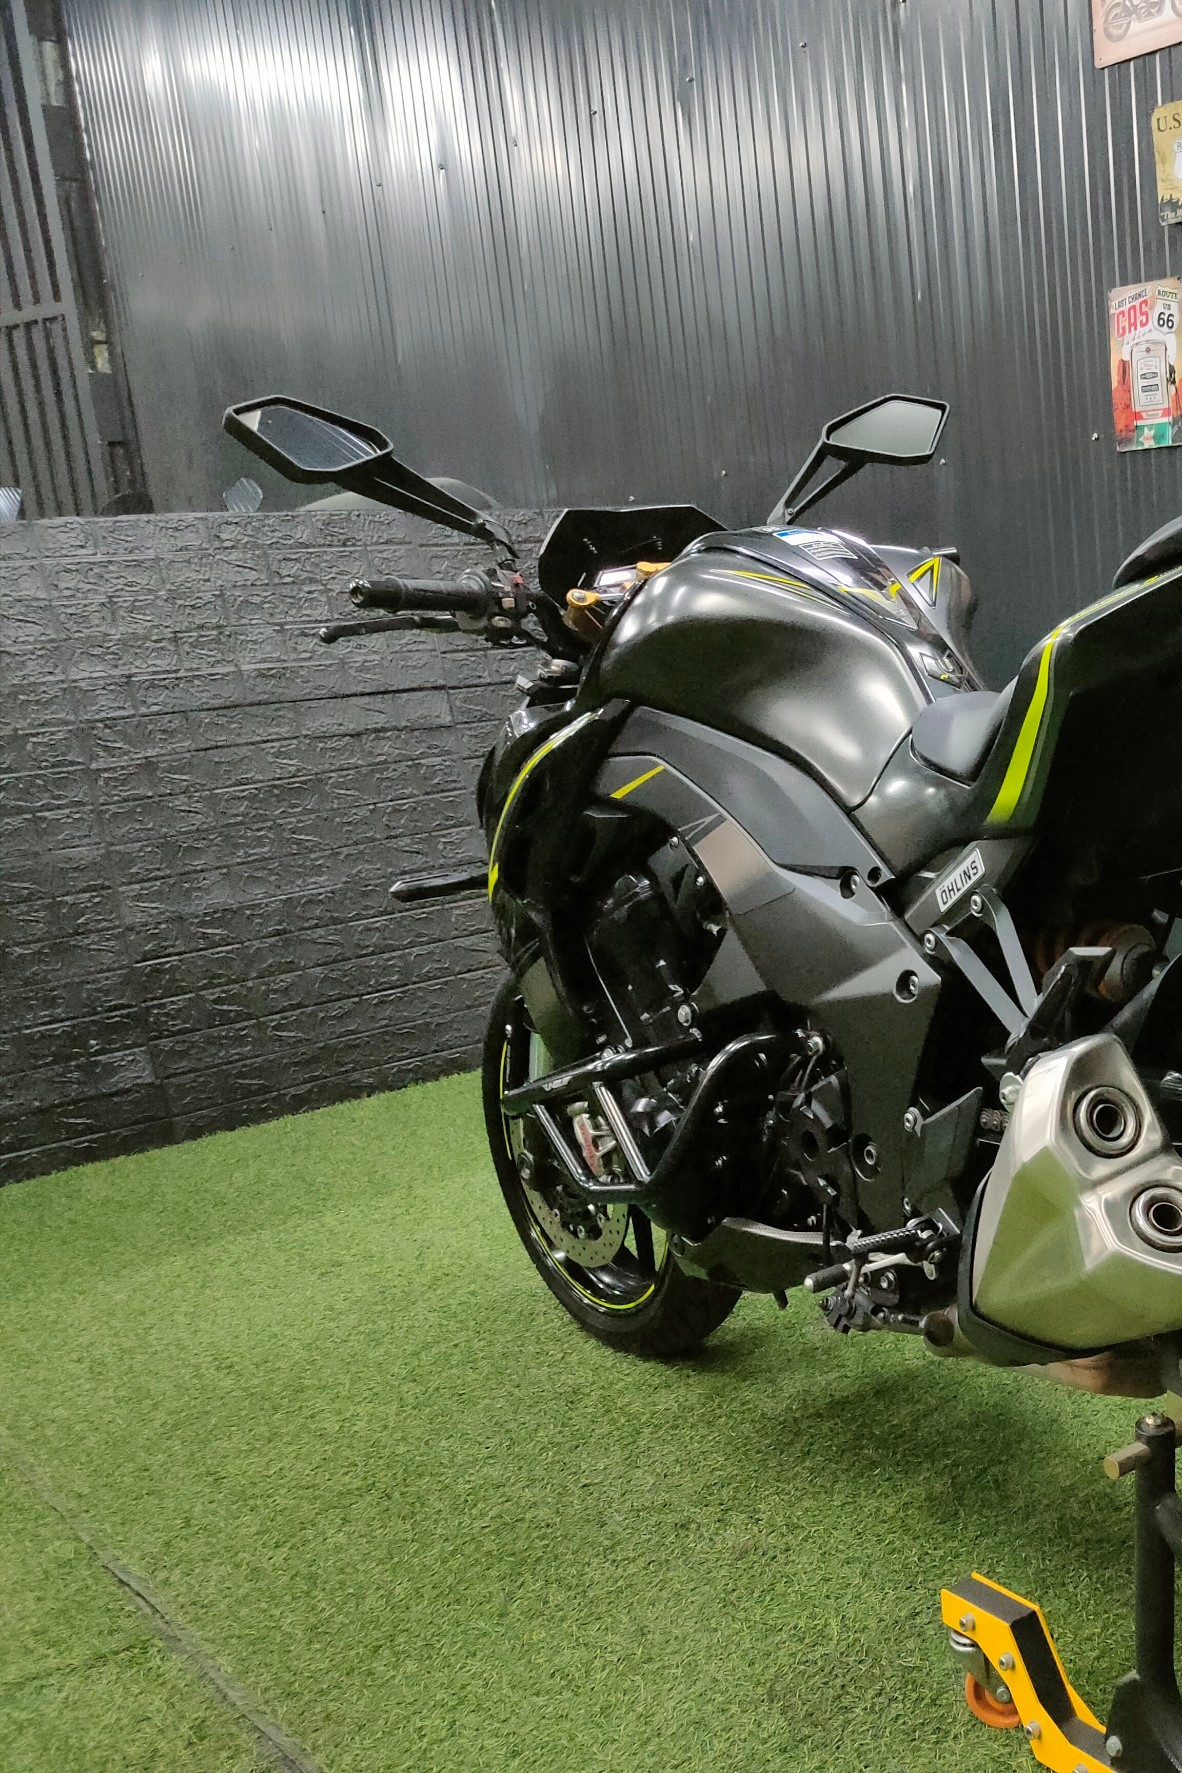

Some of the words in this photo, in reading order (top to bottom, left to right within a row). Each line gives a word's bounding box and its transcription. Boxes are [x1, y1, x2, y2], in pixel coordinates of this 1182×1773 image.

[1114, 297, 1127, 310] LAST
[1127, 287, 1148, 305] CHANCE
[1157, 289, 1179, 300] ROUTE
[1162, 302, 1172, 311] US
[1115, 298, 1150, 338] GAS
[1157, 311, 1175, 330] 66
[940, 859, 979, 906] ÖHLINS
